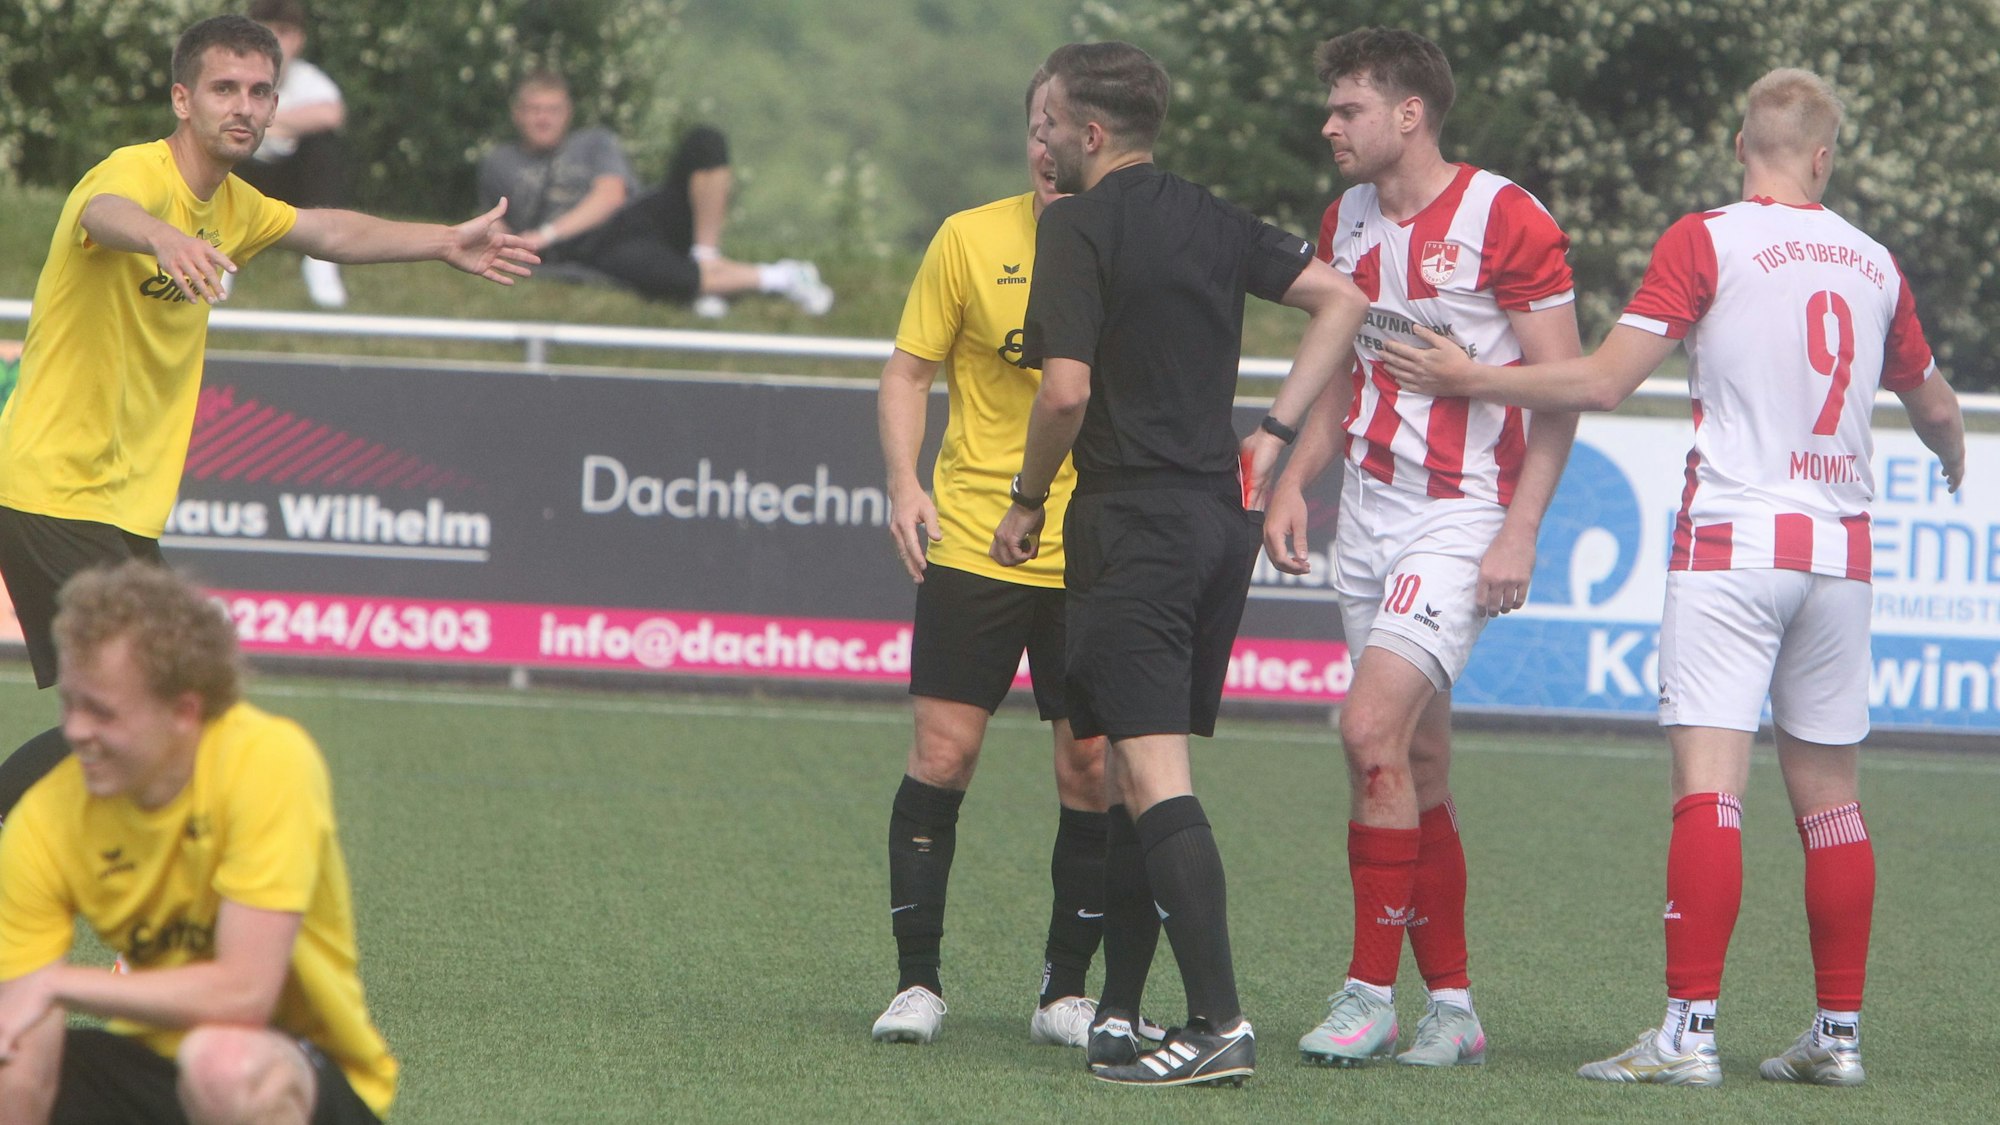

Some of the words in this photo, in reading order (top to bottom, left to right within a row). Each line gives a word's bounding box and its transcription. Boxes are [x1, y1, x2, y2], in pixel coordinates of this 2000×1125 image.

[997, 276, 1027, 285] erima
[1753, 245, 1787, 274] TUS
[1785, 240, 1805, 261] 05
[1805, 243, 1886, 290] OBERPLEIS
[1805, 289, 1855, 436] 9
[279, 492, 491, 548] Wilhelm
[1384, 573, 1421, 615] 10
[208, 596, 490, 653] 2244/6303
[1414, 612, 1440, 632] erima
